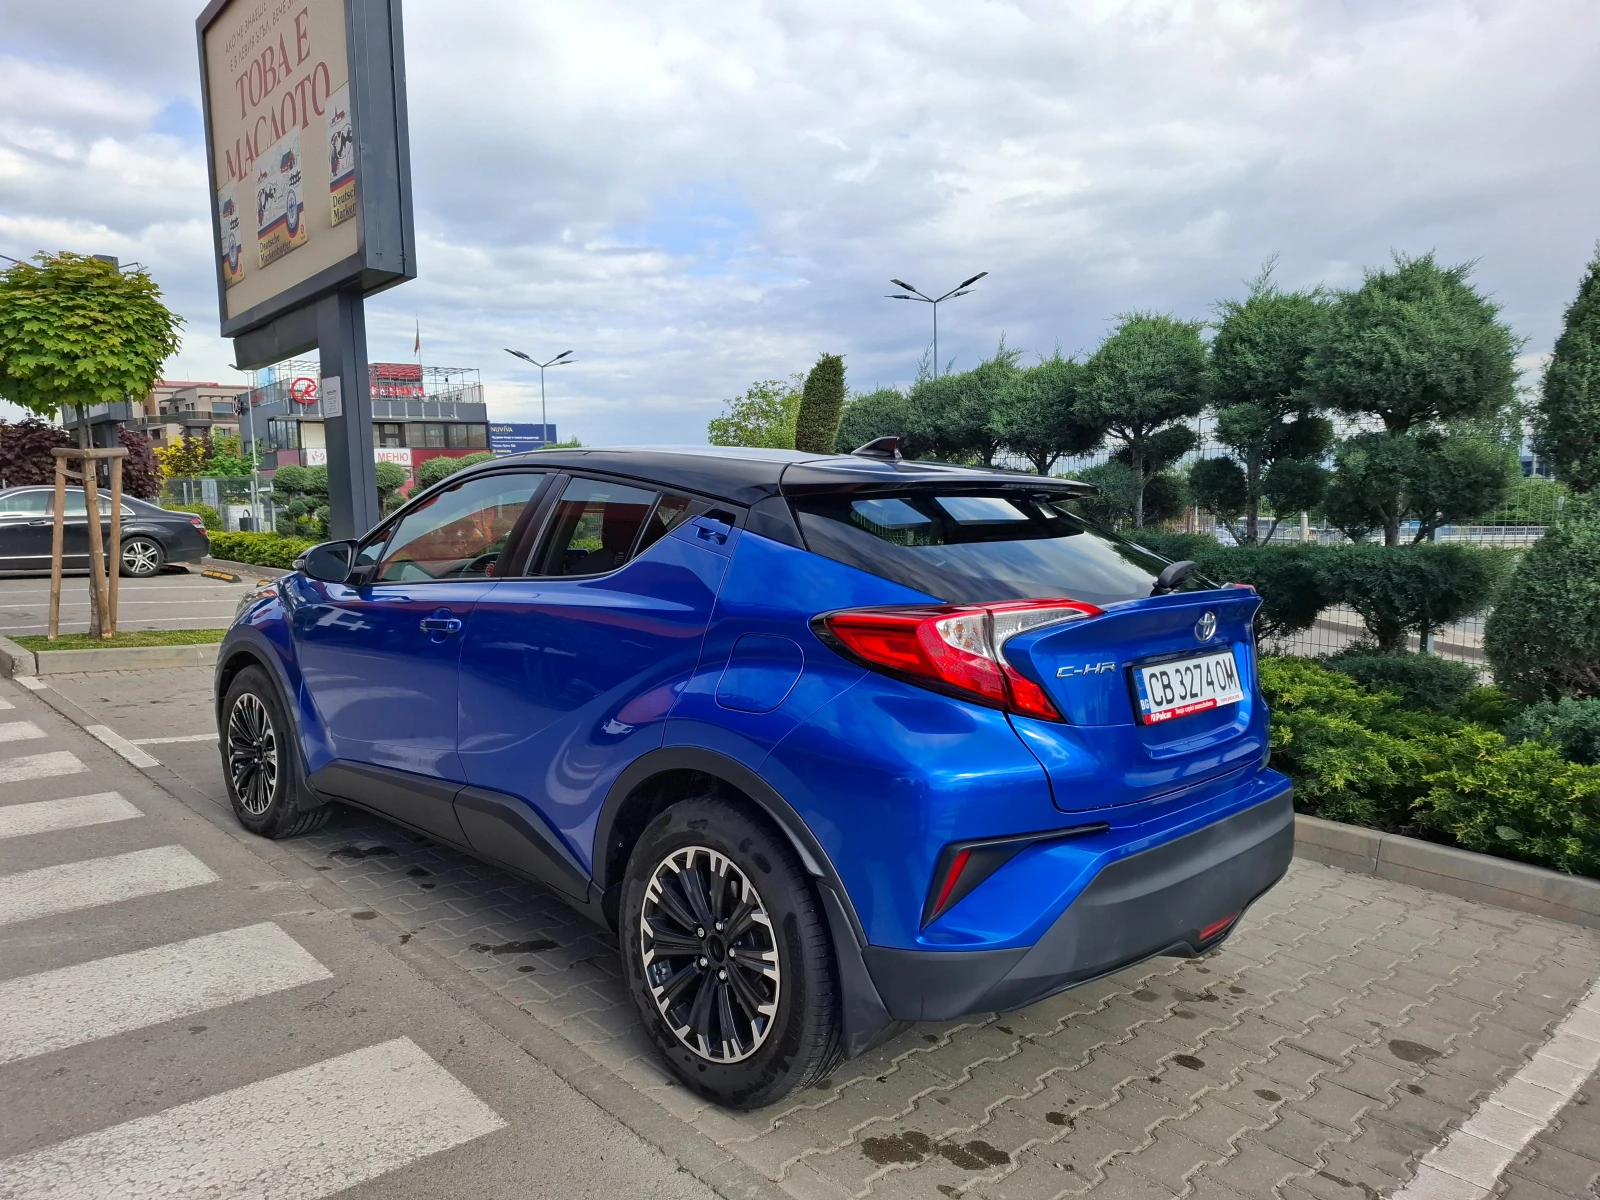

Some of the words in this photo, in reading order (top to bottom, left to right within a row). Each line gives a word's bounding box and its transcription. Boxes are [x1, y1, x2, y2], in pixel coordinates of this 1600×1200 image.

[225, 33, 236, 55] АКО
[236, 24, 244, 41] НЕ
[244, 1, 268, 34] ЗНАЕШЕ
[236, 31, 293, 120] ТОВА
[294, 6, 310, 67] Е
[225, 61, 331, 182] МАСЛОТО
[259, 233, 280, 253] Deutsche
[377, 452, 409, 463] МЕНЮ
[1056, 661, 1117, 679] C-HR
[1148, 670, 1176, 707] CB
[1175, 663, 1216, 701] 3274
[1215, 657, 1239, 691] OM
[1140, 698, 1150, 710] BG
[1155, 711, 1173, 722] Polcar
